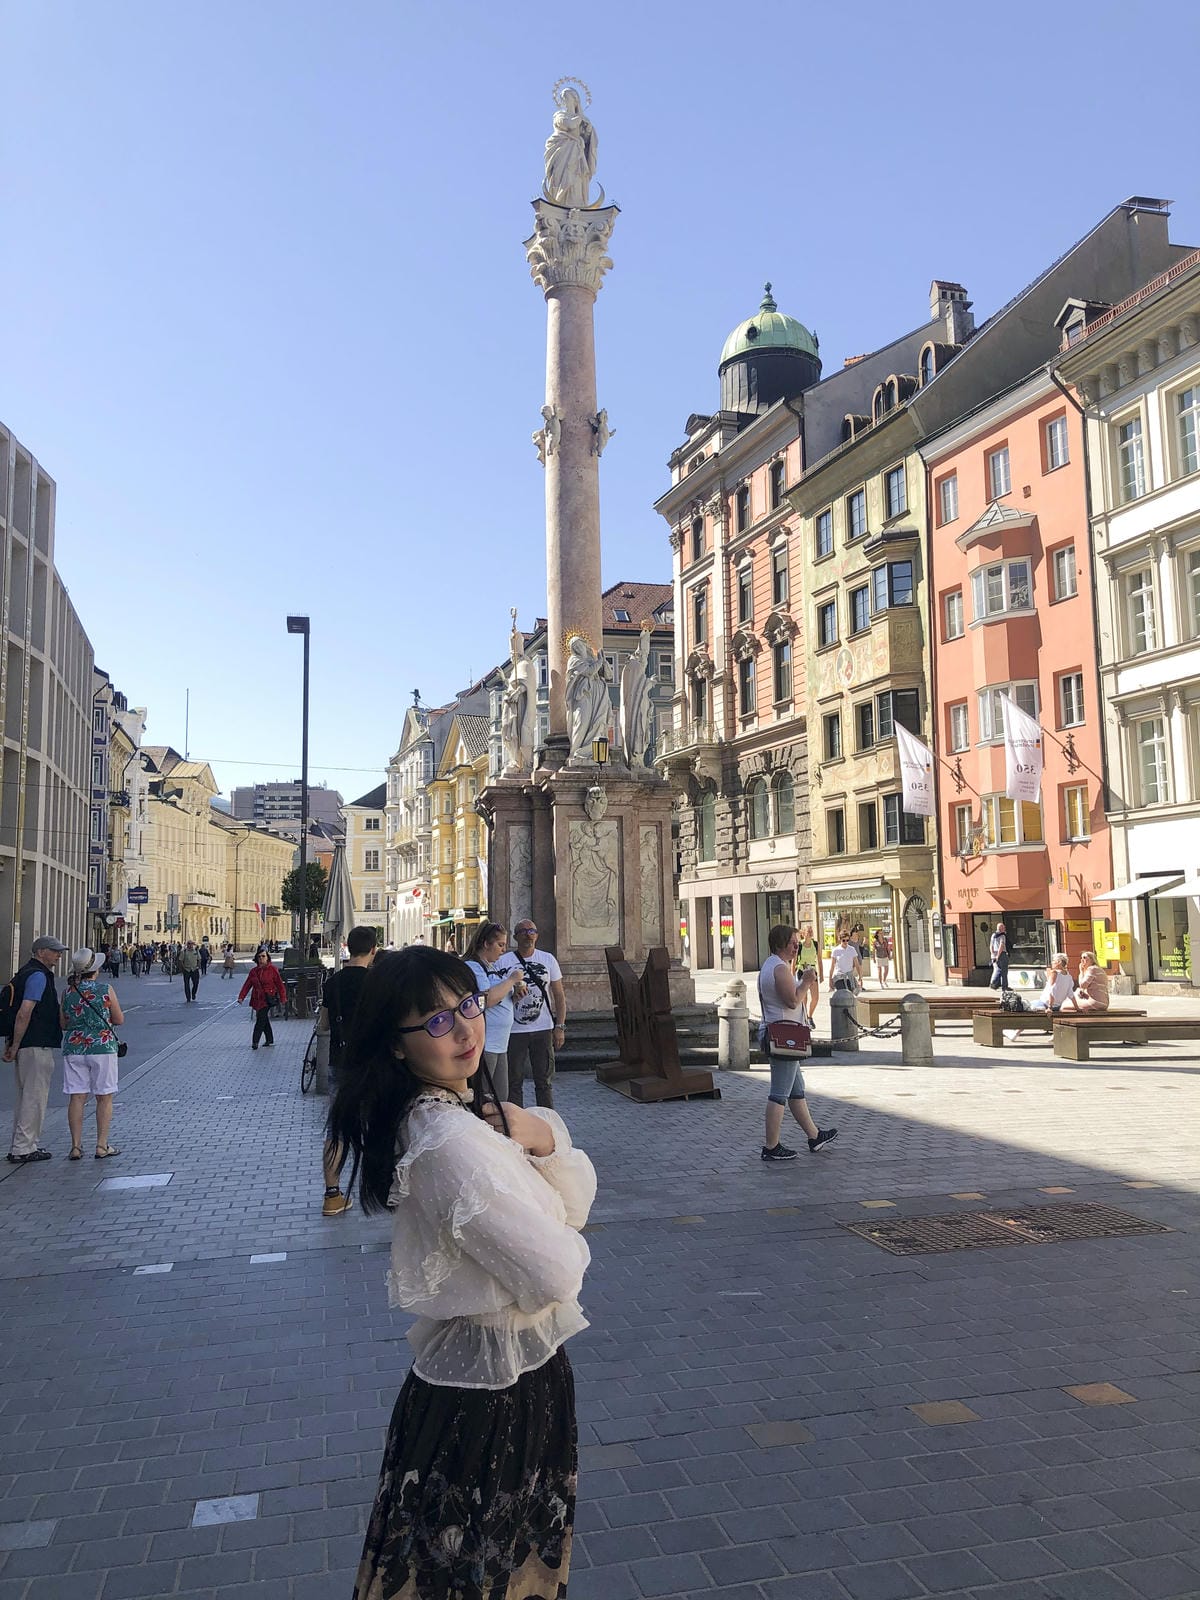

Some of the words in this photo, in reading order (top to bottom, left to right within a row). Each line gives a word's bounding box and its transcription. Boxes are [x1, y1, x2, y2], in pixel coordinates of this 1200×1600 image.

[1, 596, 10, 704] KAUFHAUS
[24, 608, 32, 689] PREMIUM
[20, 699, 29, 794] SHOPPING
